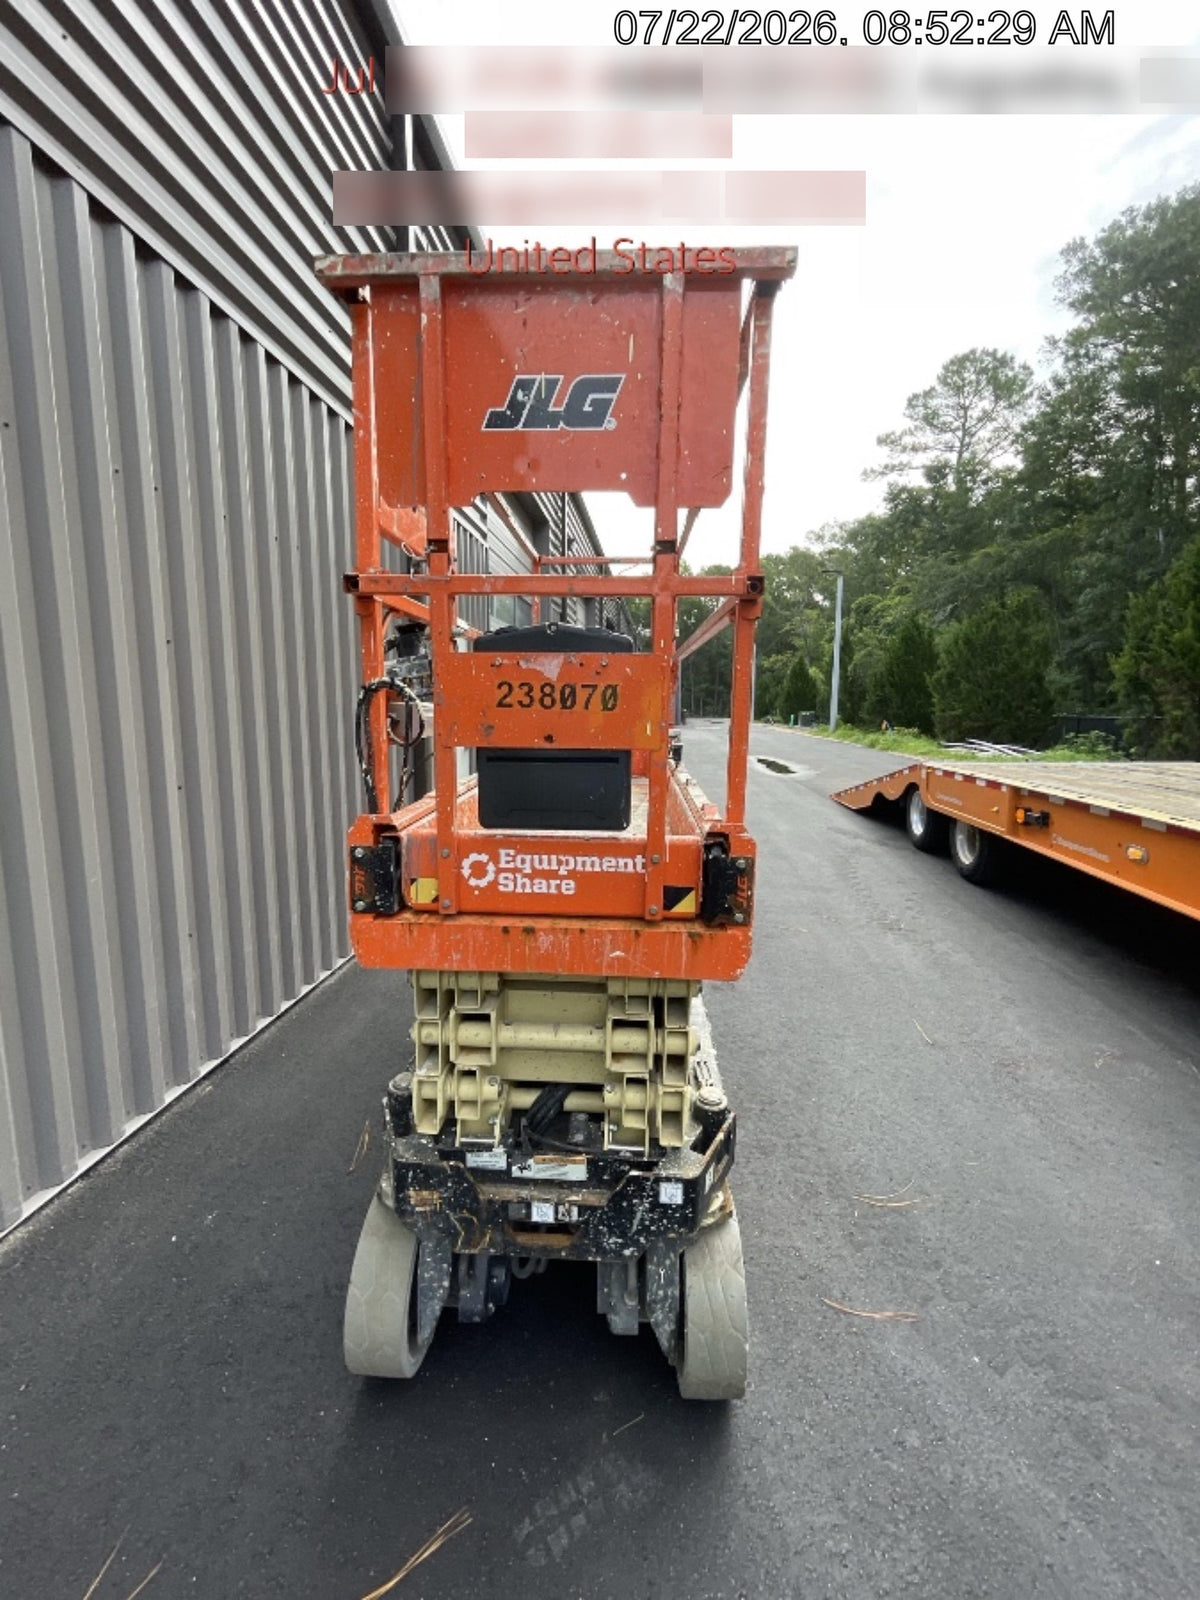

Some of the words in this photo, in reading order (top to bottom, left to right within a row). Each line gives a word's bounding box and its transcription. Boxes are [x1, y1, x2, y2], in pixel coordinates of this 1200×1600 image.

[481, 374, 626, 431] JLG
[496, 681, 619, 711] 238070
[498, 848, 647, 875] Equipment
[498, 872, 577, 895] Share
